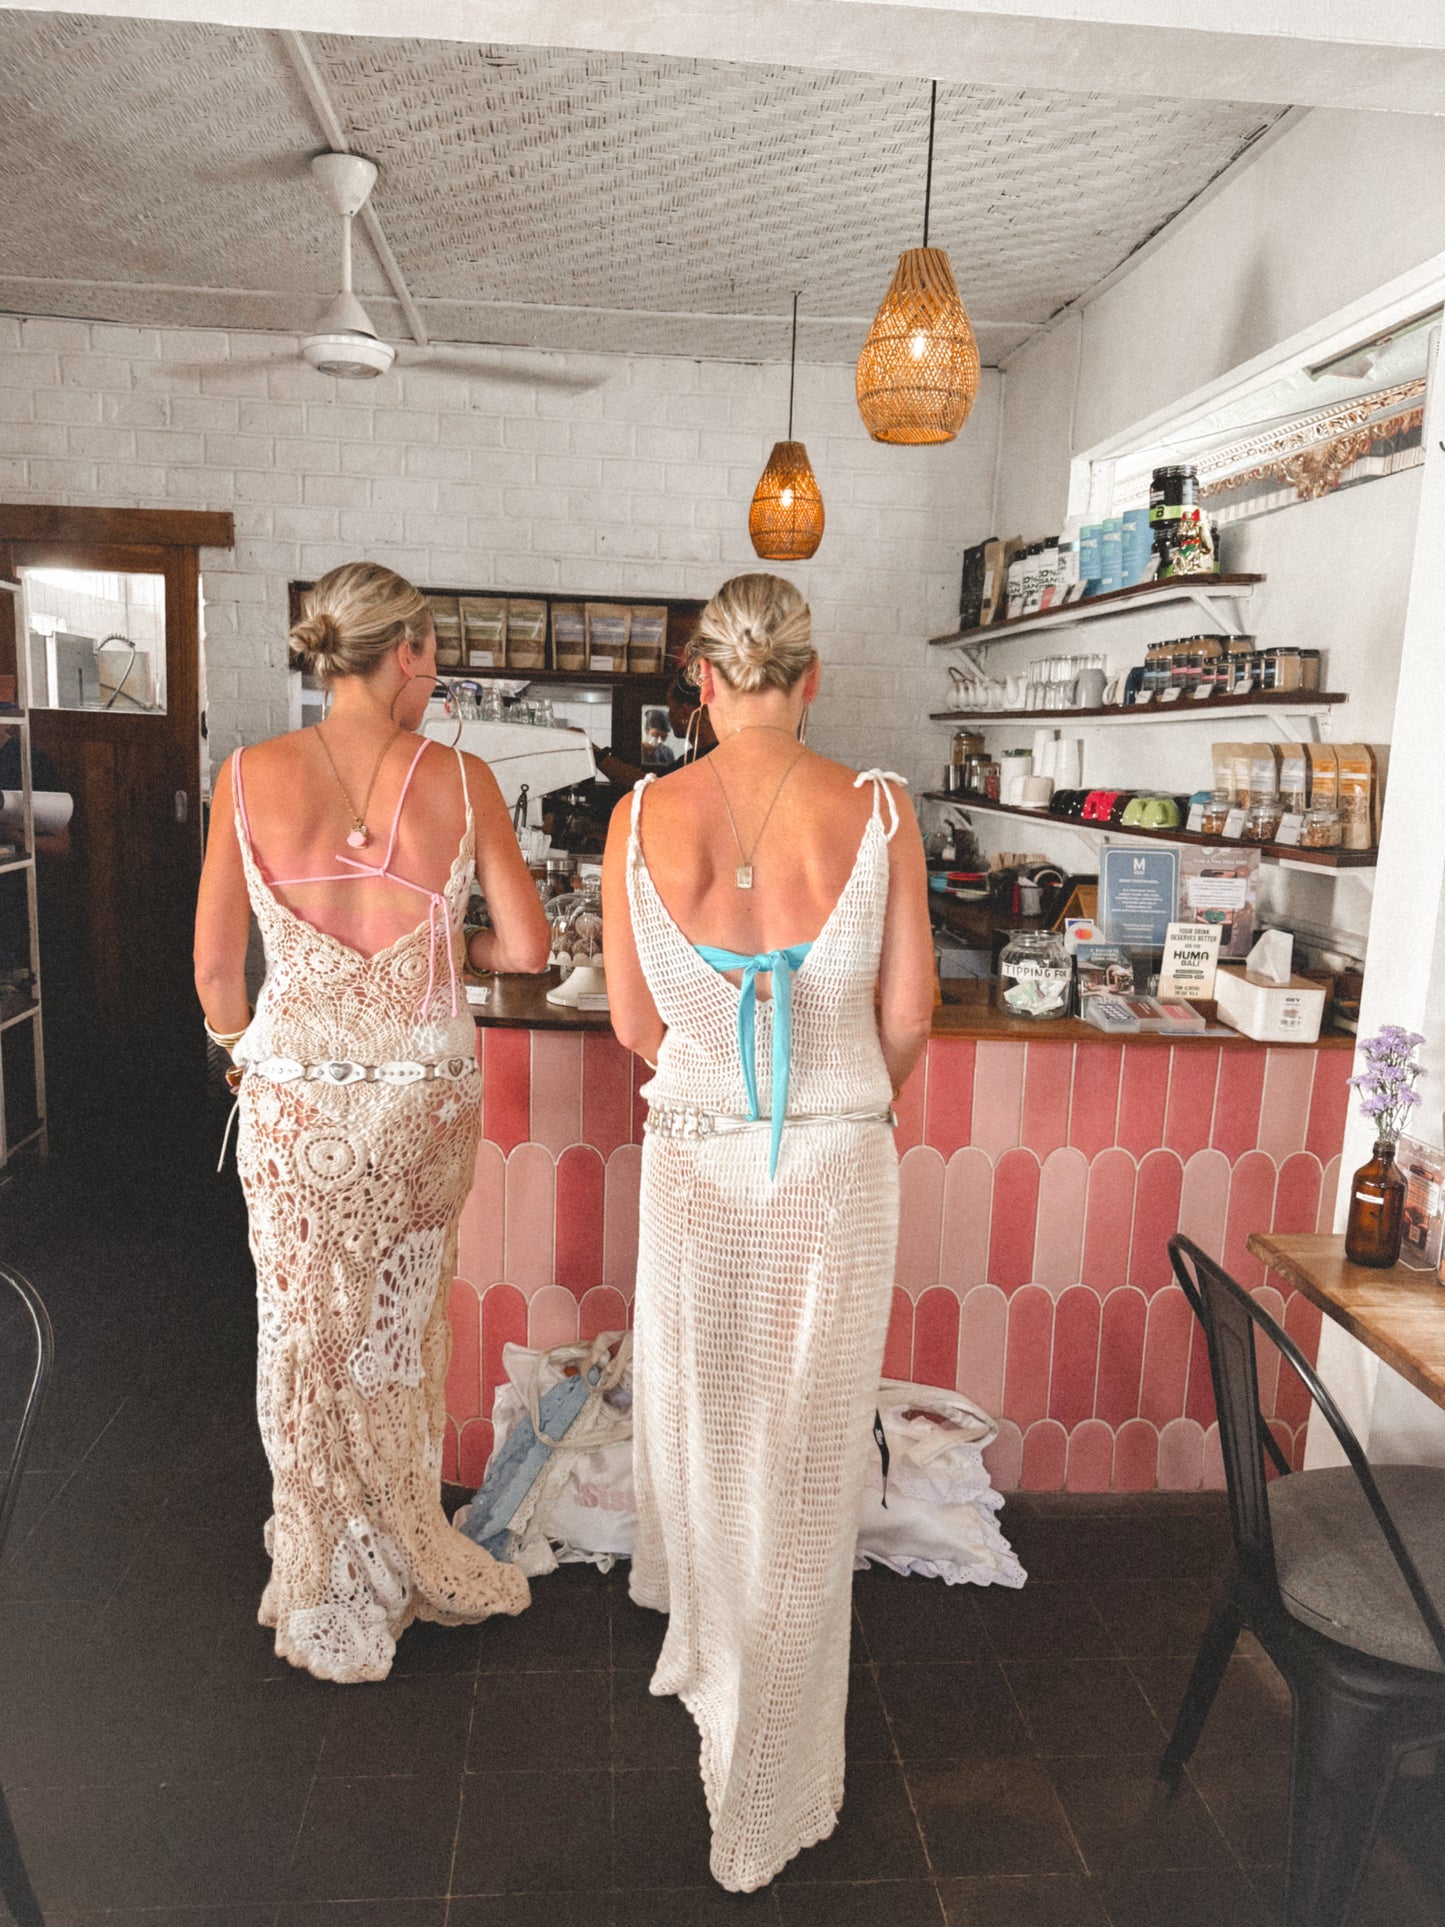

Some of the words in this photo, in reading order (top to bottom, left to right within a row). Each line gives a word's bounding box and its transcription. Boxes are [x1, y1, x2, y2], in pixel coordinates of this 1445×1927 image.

[1133, 858, 1146, 870] M
[1170, 934, 1196, 942] DESERVES
[1197, 935, 1217, 943] BETTER
[1173, 951, 1209, 961] HUMA
[1004, 965, 1051, 978] TIPPING
